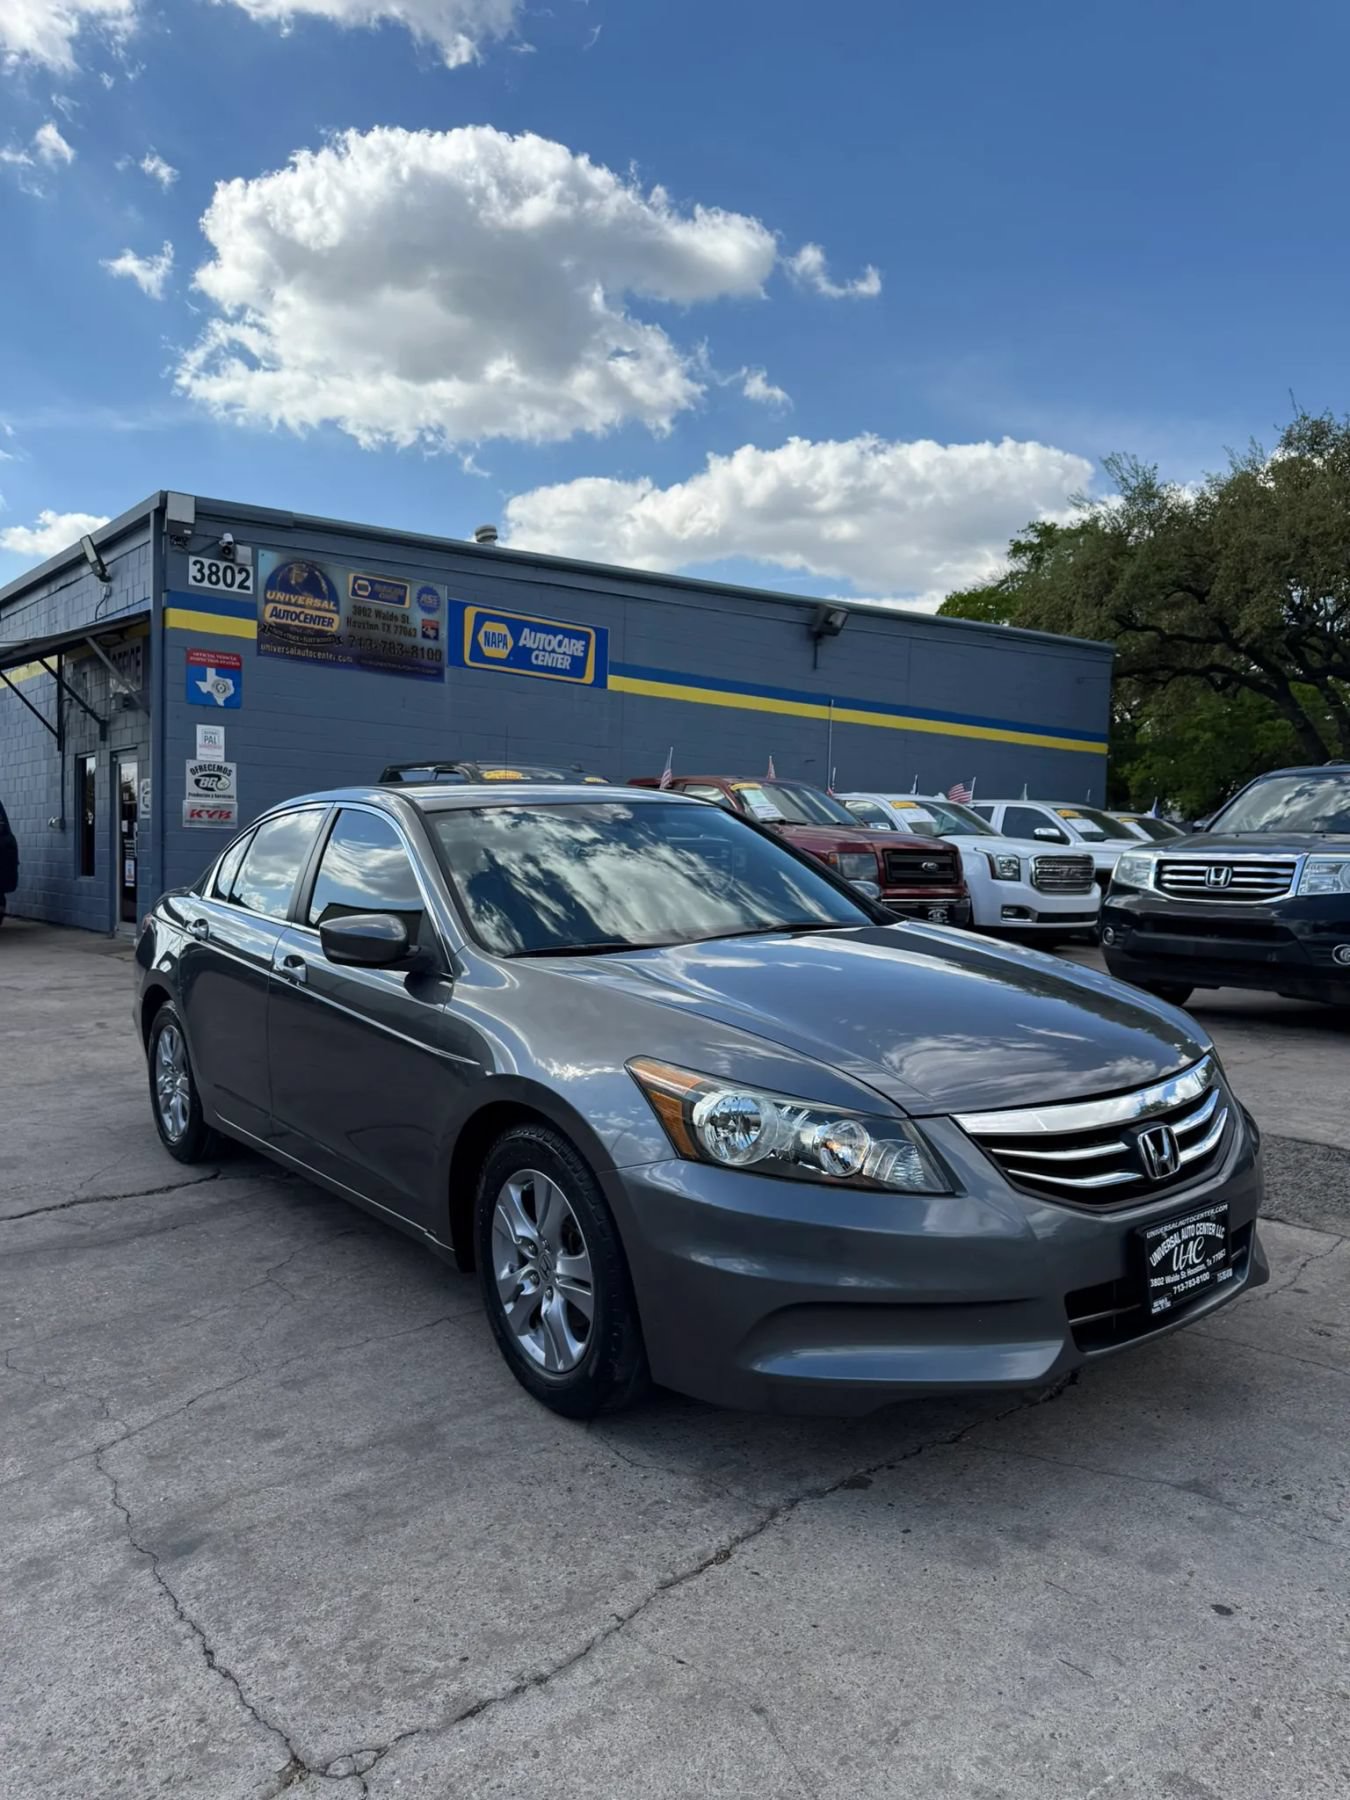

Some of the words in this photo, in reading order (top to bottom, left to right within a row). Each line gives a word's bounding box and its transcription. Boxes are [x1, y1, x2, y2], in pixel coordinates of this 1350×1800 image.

[191, 559, 251, 591] 3802
[266, 590, 337, 610] UNIVERSAL
[352, 605, 372, 618] 3802
[375, 608, 399, 622] Waldo
[346, 616, 379, 630] Houston
[381, 622, 392, 633] TX
[347, 634, 442, 662] 713-783-8100
[484, 630, 509, 651] NAPA
[260, 643, 353, 664] universalautocenter.com
[531, 650, 572, 670] CENTER
[189, 763, 233, 777] OFRECEMOS
[189, 808, 233, 819] KYB
[1150, 1231, 1181, 1267] UNIVERSAL
[1181, 1224, 1195, 1240] AUTO
[1195, 1222, 1216, 1236] CENTER
[1215, 1224, 1226, 1239] LLC
[1172, 1236, 1206, 1271] UAC
[1150, 1277, 1164, 1287] 3802
[1172, 1271, 1210, 1295] 713-783-8100
